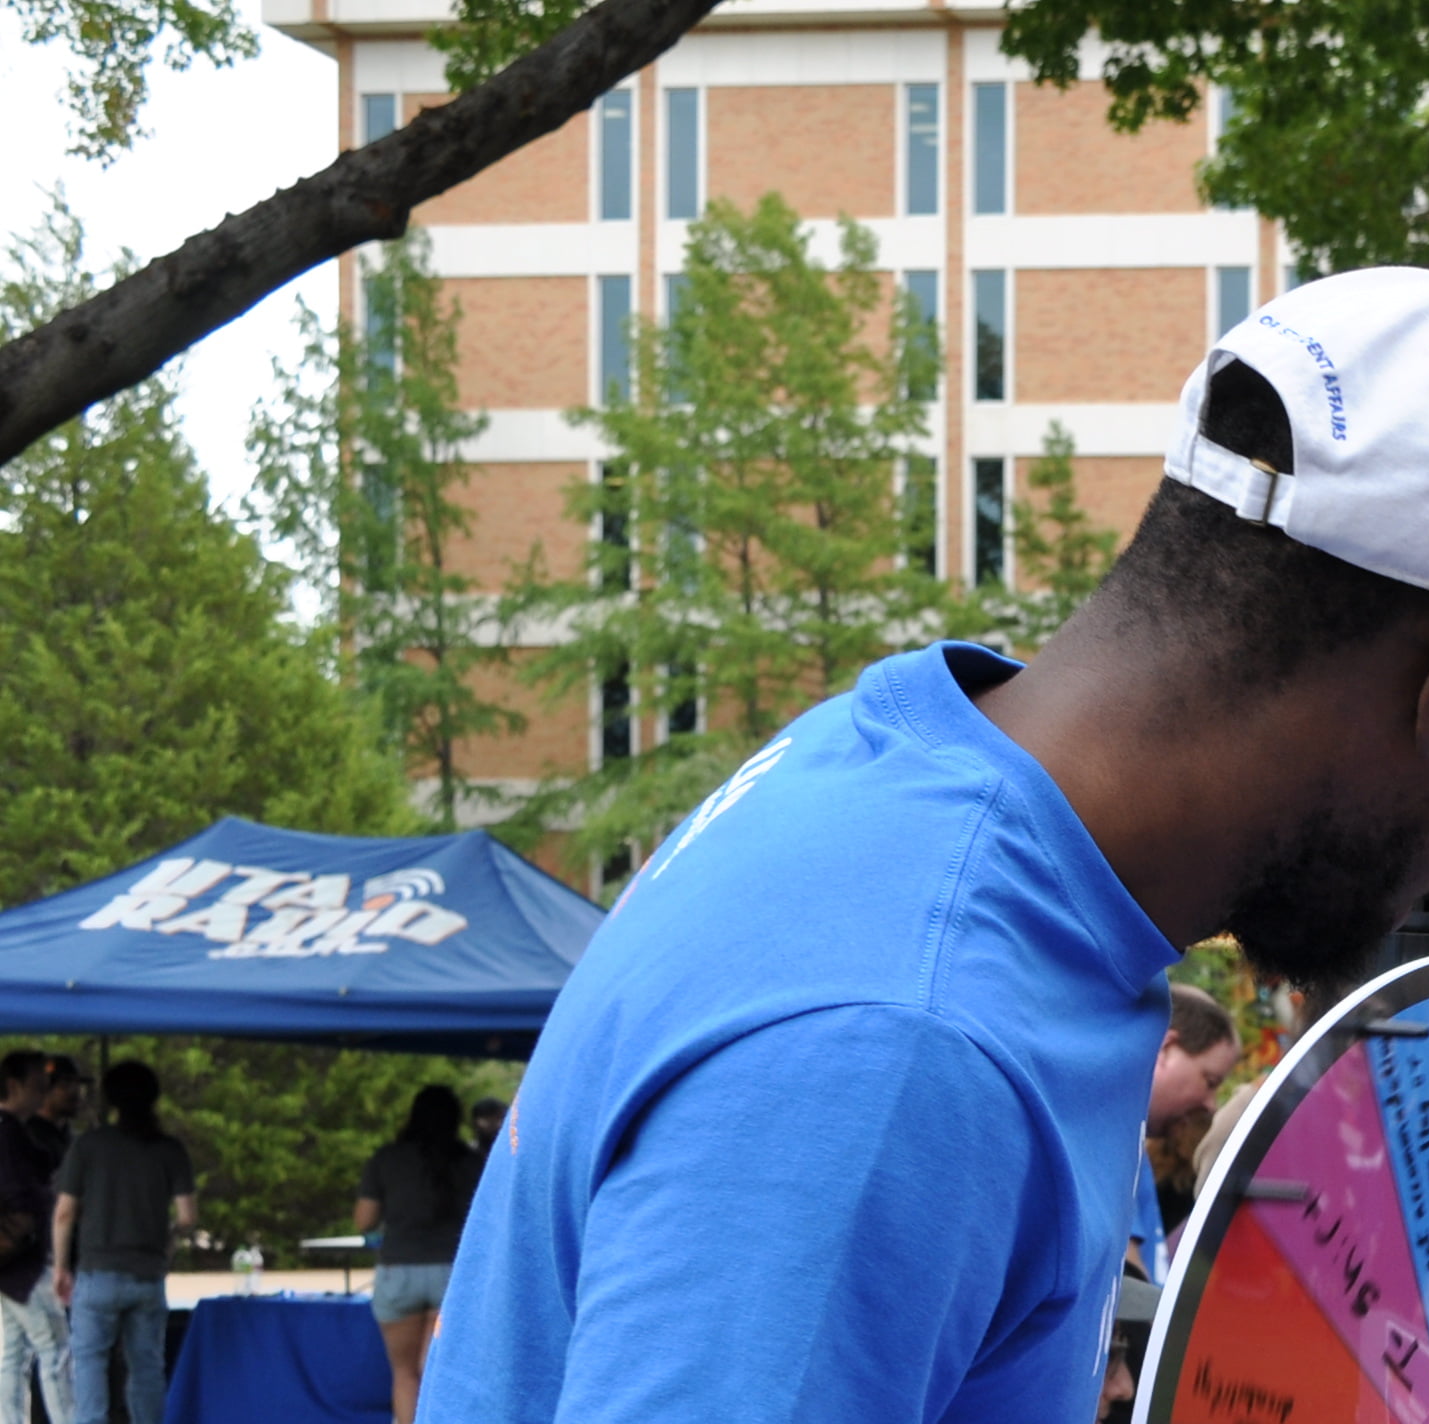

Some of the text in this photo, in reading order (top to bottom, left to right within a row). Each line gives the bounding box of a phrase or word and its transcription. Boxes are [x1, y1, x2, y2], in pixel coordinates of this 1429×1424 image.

[1322, 373, 1347, 441] AFFAIRS
[128, 856, 351, 909] UTA
[79, 893, 468, 945] RADIO
